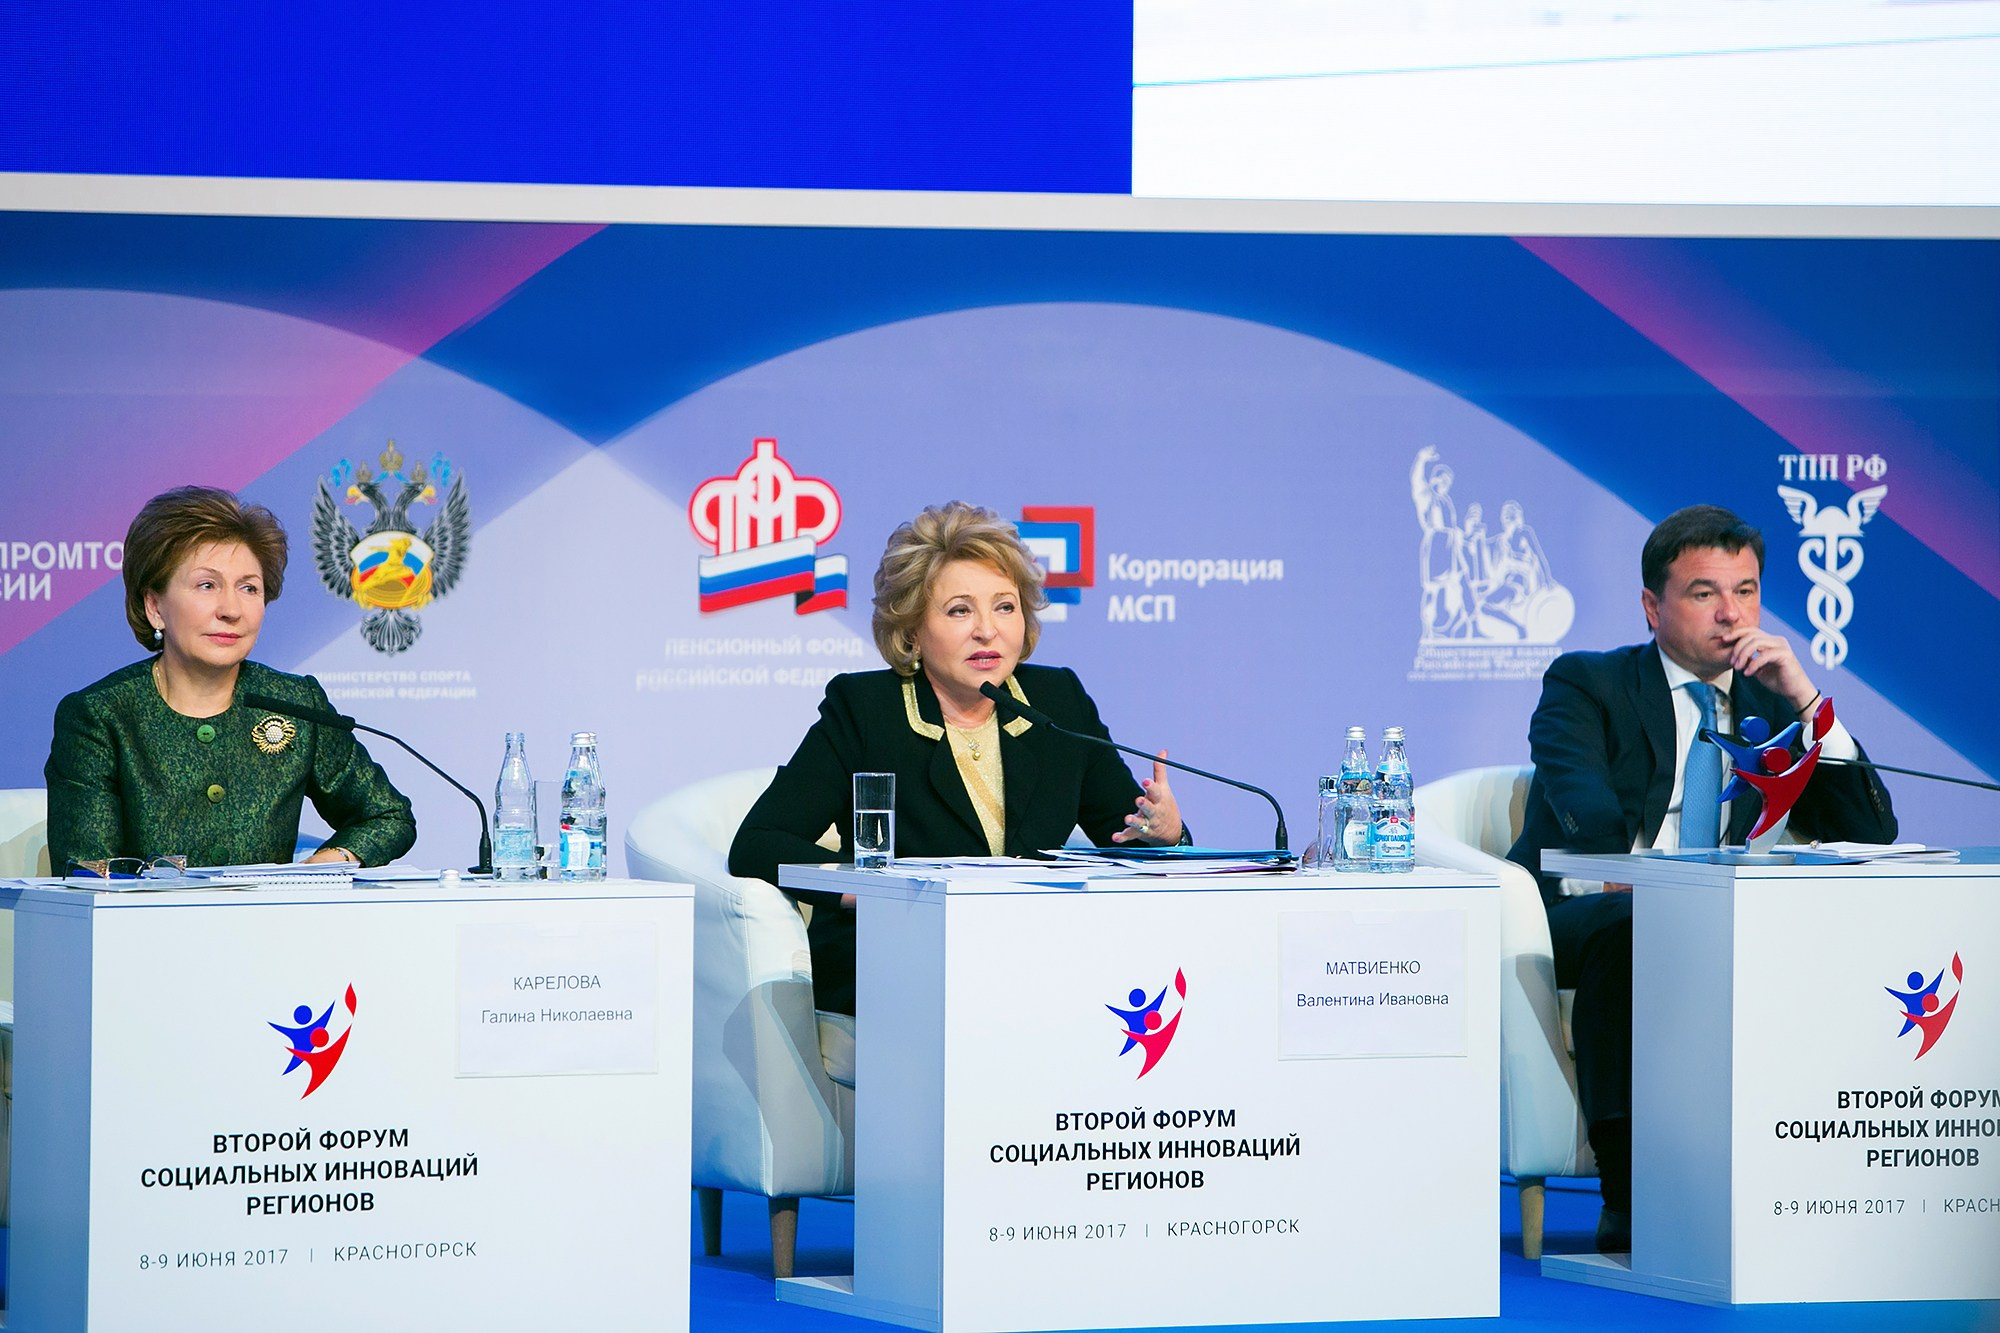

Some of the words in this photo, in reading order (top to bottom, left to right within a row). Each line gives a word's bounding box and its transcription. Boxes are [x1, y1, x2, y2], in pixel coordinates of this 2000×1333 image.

[1778, 453, 1839, 481] ТПП
[1846, 453, 1888, 481] РФ
[1108, 553, 1284, 588] Корпорация
[0, 572, 52, 601] ИИ
[1107, 595, 1176, 623] МСП
[665, 635, 802, 660] ПЕНСИОННЫЙ
[806, 637, 865, 657] ФОНД
[420, 671, 471, 683] СПОРТА
[773, 666, 842, 688] ФЕДЕР
[397, 687, 477, 699] ФЕДЕРАЦИИ
[1326, 960, 1421, 975] МАТВИЕНКО
[513, 974, 602, 991] КАРЕЛОВА
[1297, 993, 1375, 1008] Валентина
[1379, 992, 1449, 1006] Ивановна
[481, 1009, 536, 1024] Галина
[540, 1008, 633, 1023] Николаевна
[1837, 1085, 1924, 1110] ВТОРОЙ
[1055, 1106, 1146, 1132] ВТОРОЙ
[1152, 1108, 1236, 1130] ФОРУМ
[1775, 1119, 1930, 1143] СОЦИАЛЬНЫХ
[1935, 1118, 2000, 1138] ИННО
[213, 1127, 311, 1154] ВТОРОЙ
[318, 1128, 409, 1151] ФОРУМ
[989, 1140, 1152, 1167] СОЦИАЛЬНЫХ
[1158, 1132, 1300, 1161] ИННОВАЦИЙ
[1866, 1148, 1980, 1168] РЕГИОНОВ
[140, 1162, 318, 1191] СОЦИАЛЬНЫХ
[325, 1152, 478, 1182] ИННОВАЦИЙ
[1086, 1170, 1205, 1191] РЕГИОНОВ
[246, 1192, 375, 1216] РЕГИОНОВ
[1773, 1200, 1799, 1216] 8-9
[1806, 1199, 1858, 1215] ИЮНЯ
[1864, 1199, 1905, 1214] 2017
[989, 1226, 1015, 1242] 8-9
[1023, 1224, 1077, 1241] ИЮНЯ
[1084, 1223, 1127, 1239] 2017
[1167, 1218, 1300, 1237] КРАСНОГОРСК
[139, 1253, 168, 1271] 8-9
[177, 1251, 236, 1269] ИЮНЯ
[244, 1248, 288, 1266] 2017
[334, 1241, 477, 1262] КРАСНОГОРСК
